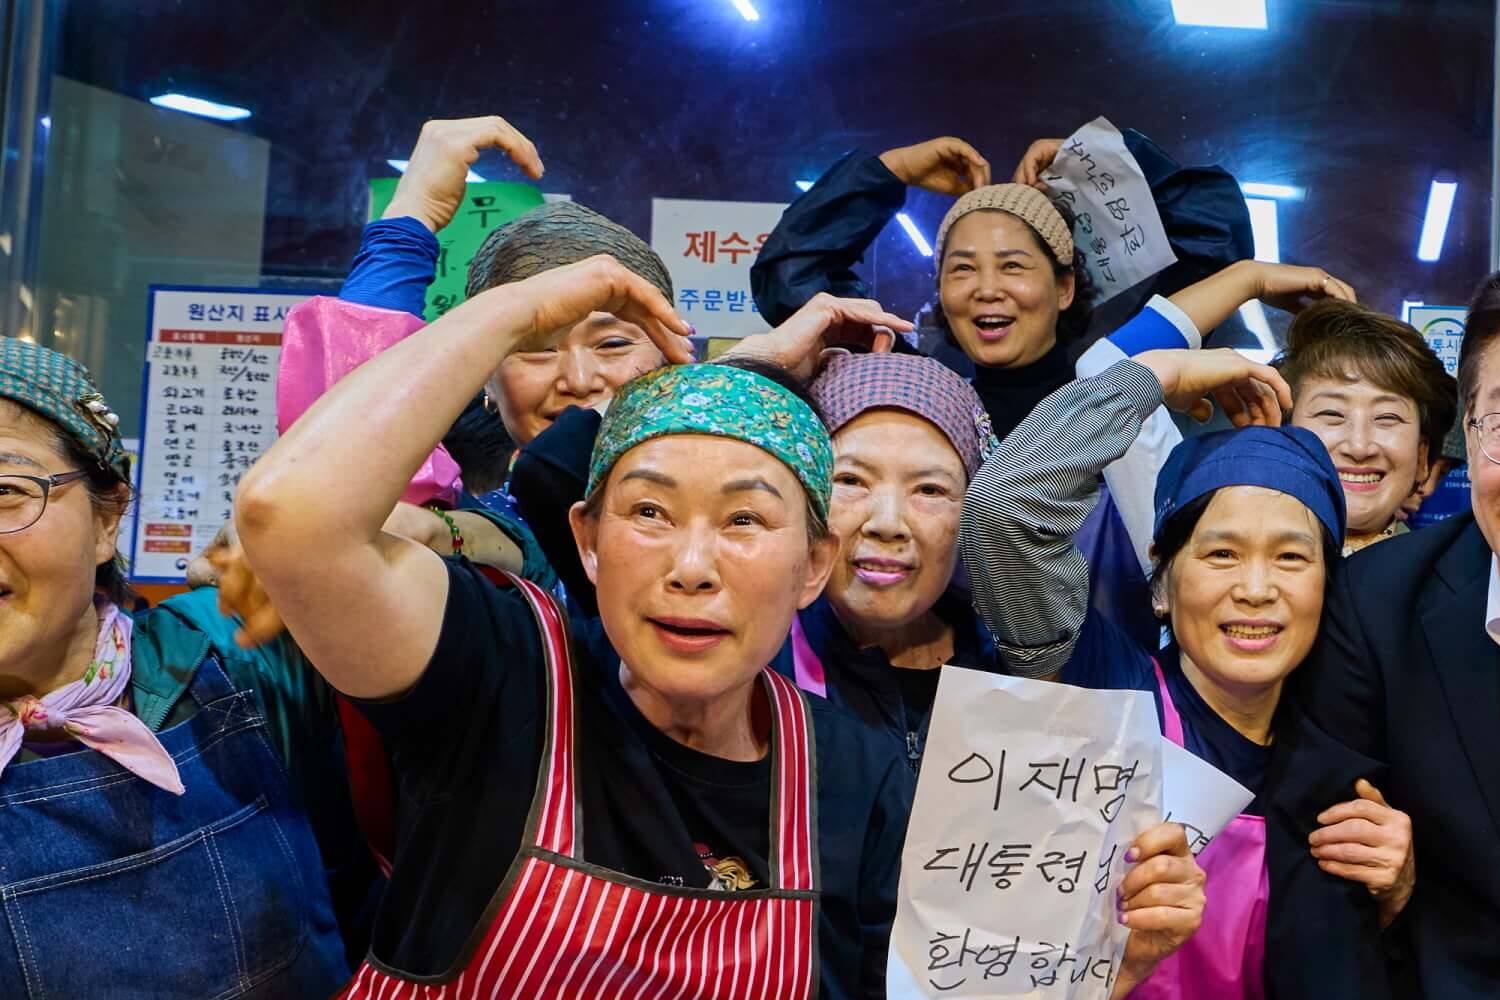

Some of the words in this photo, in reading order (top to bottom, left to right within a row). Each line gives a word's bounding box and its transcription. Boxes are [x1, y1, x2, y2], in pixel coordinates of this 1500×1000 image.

[188, 303, 245, 322] 원산지
[678, 288, 760, 313] 주문받
[947, 749, 1140, 823] 이재명
[922, 841, 1118, 895] 대통령님
[926, 928, 1115, 991] 환영합니다
